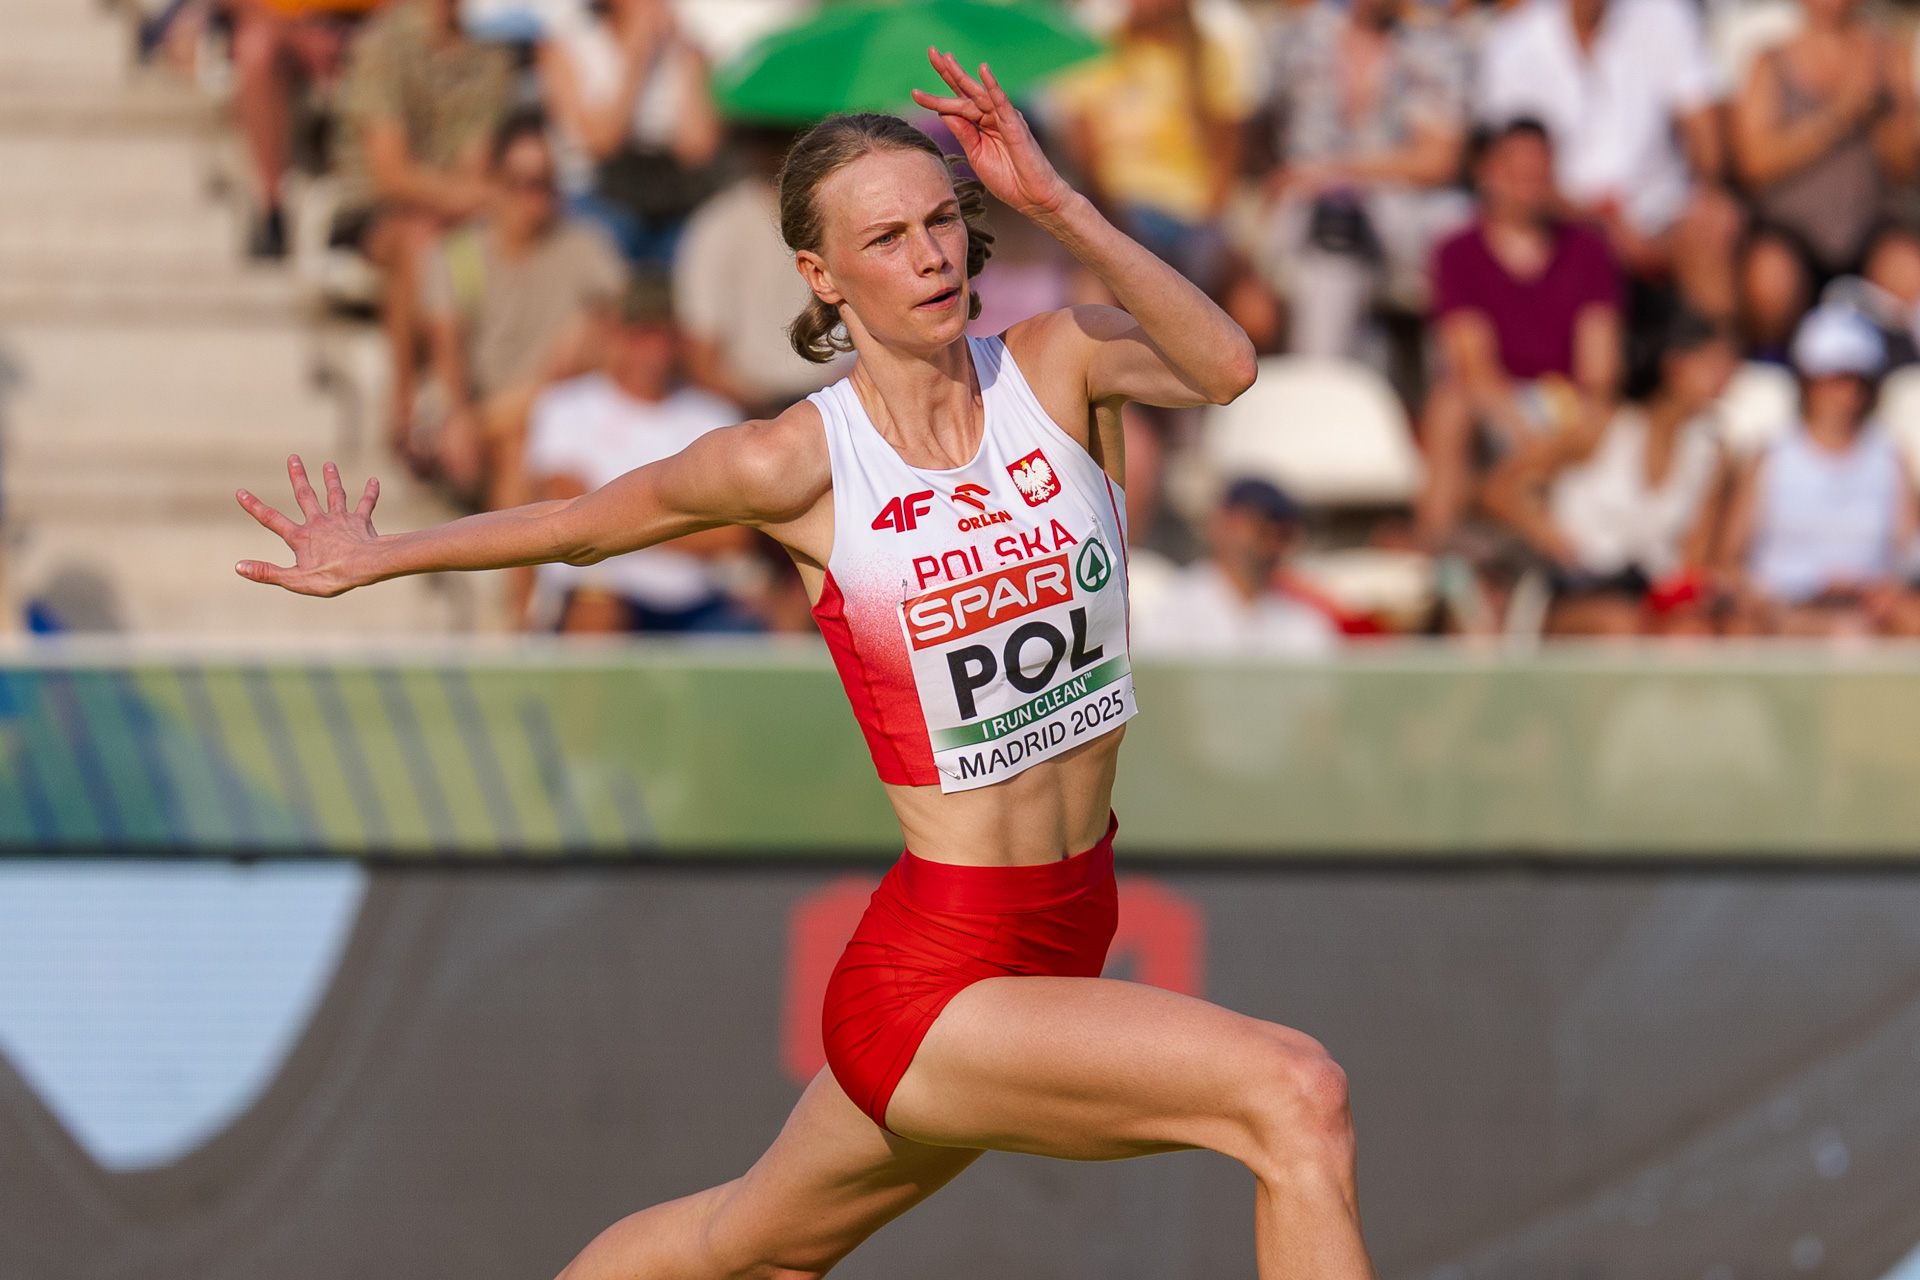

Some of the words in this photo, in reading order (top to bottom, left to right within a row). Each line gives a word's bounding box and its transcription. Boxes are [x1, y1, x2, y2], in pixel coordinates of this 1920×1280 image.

[957, 510, 1013, 532] ORLEN
[909, 562, 1069, 641] SPAR
[946, 606, 1104, 721] POL
[958, 721, 1067, 780] MADRID
[1070, 689, 1125, 737] 2025
[981, 723, 989, 740] I
[992, 704, 1033, 736] RUN
